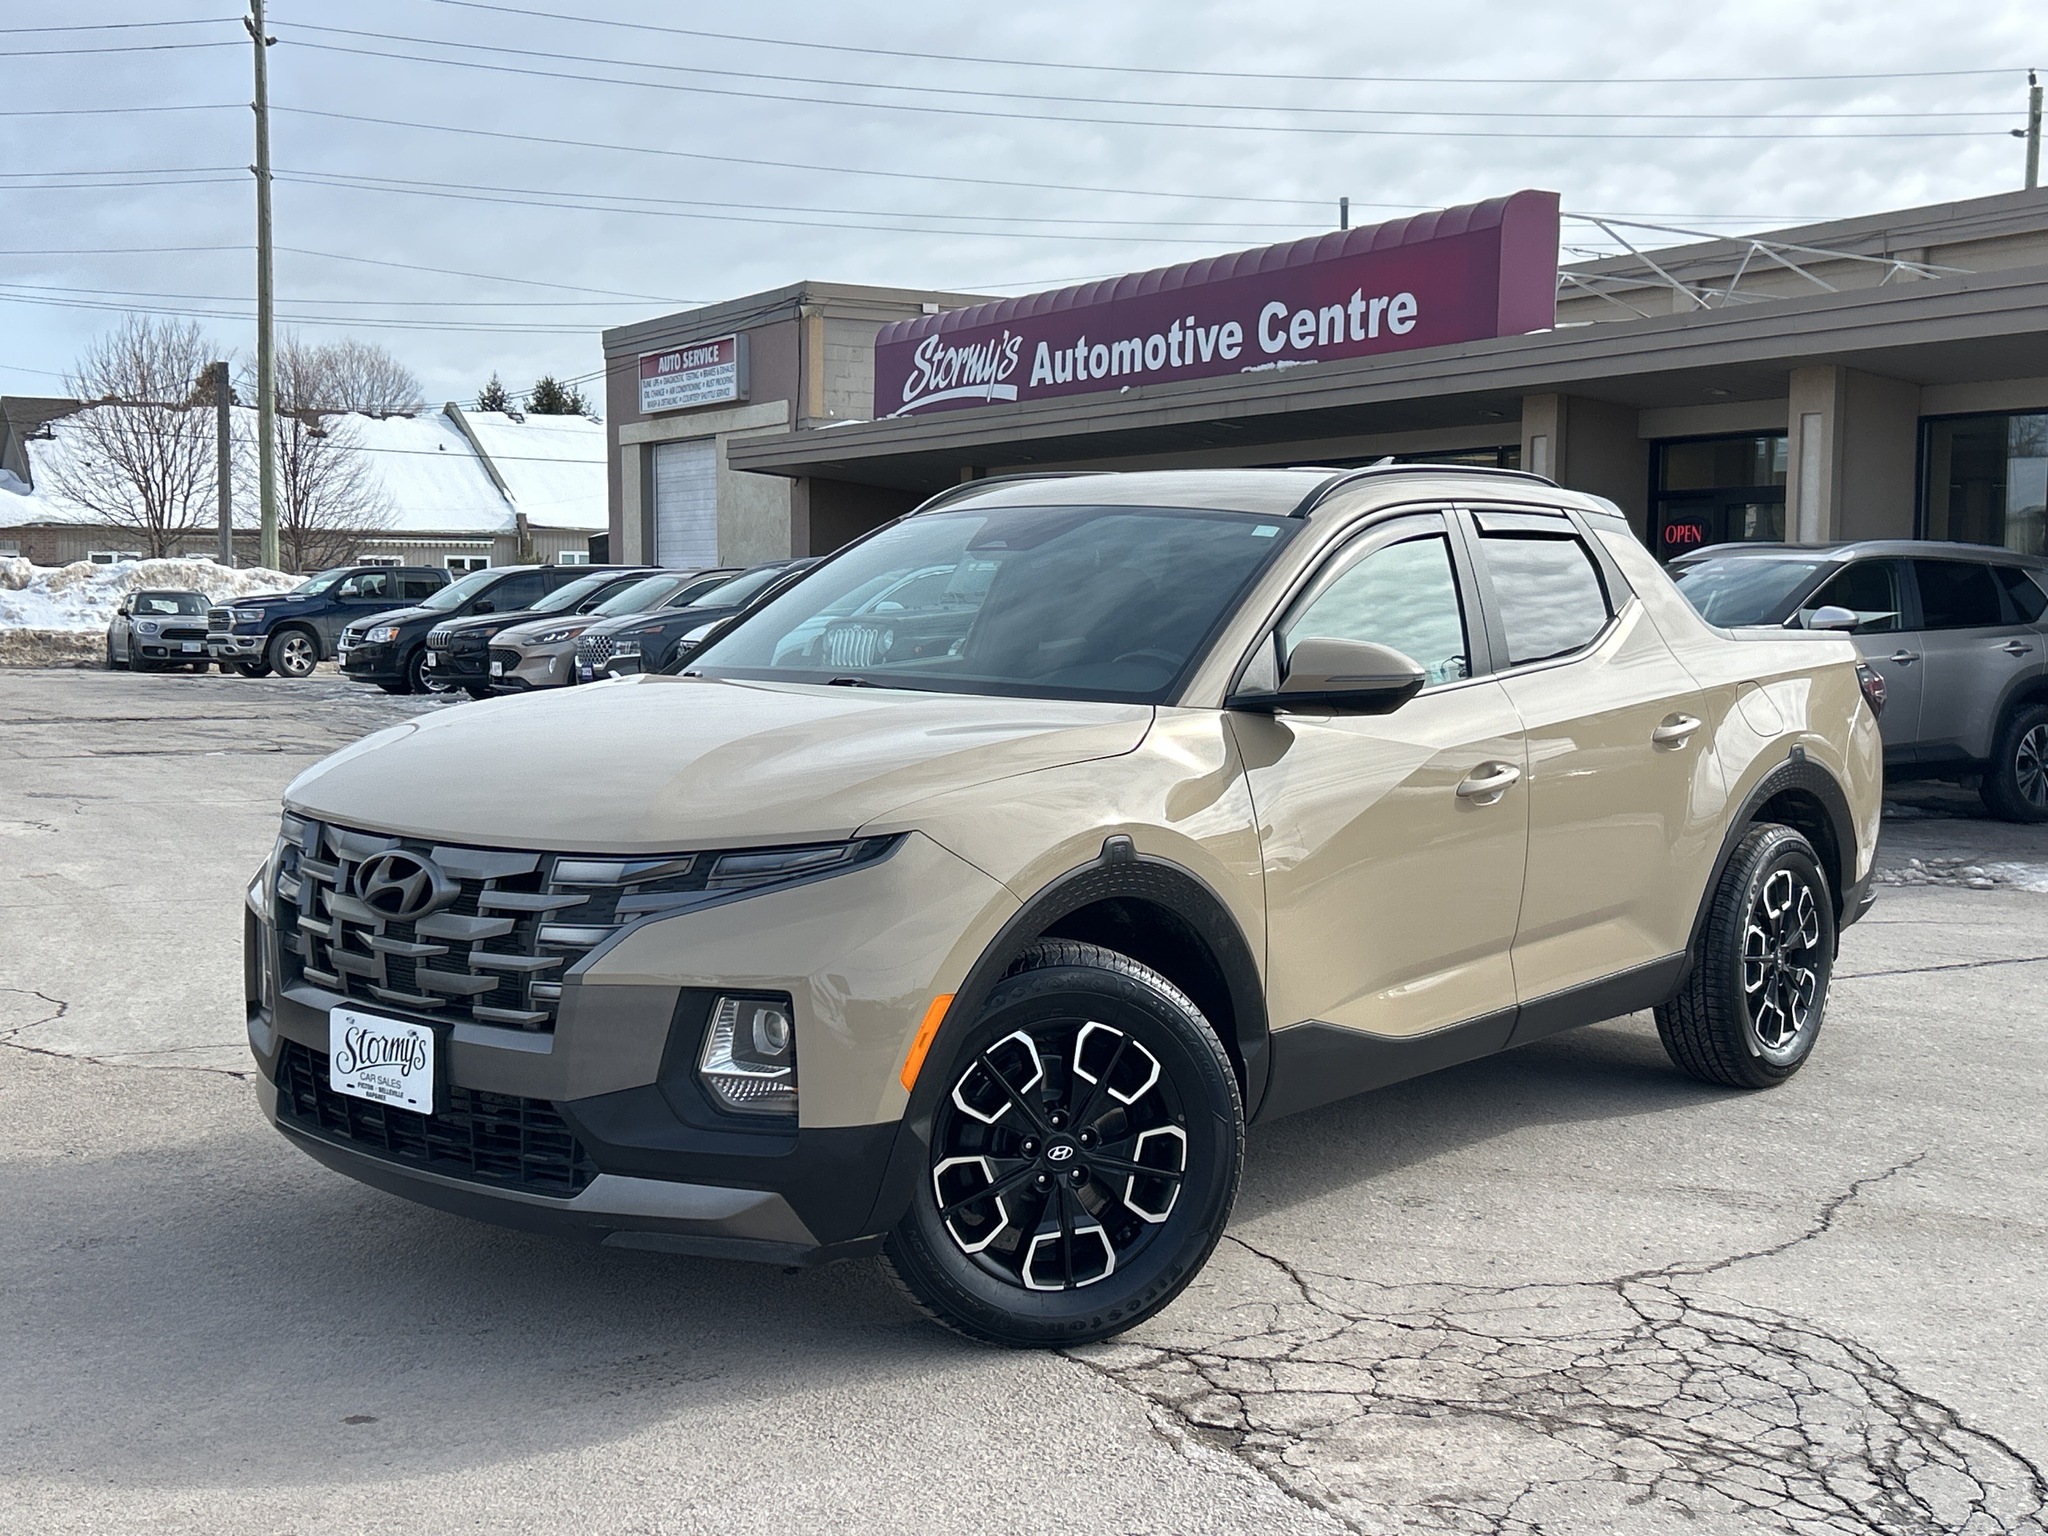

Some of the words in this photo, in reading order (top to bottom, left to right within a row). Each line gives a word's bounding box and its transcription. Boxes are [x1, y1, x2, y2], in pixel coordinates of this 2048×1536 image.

[902, 329, 1023, 403] Stormy's
[1029, 315, 1243, 388] Automotive
[1257, 287, 1418, 354] Centre
[657, 354, 681, 374] AUTO
[682, 345, 719, 369] SERVICE
[1664, 525, 1702, 544] OPEN
[336, 1026, 427, 1077] Stormy's
[360, 1071, 376, 1083] CAR
[377, 1075, 402, 1090] SALES
[378, 1086, 404, 1099] BELLEVILLE
